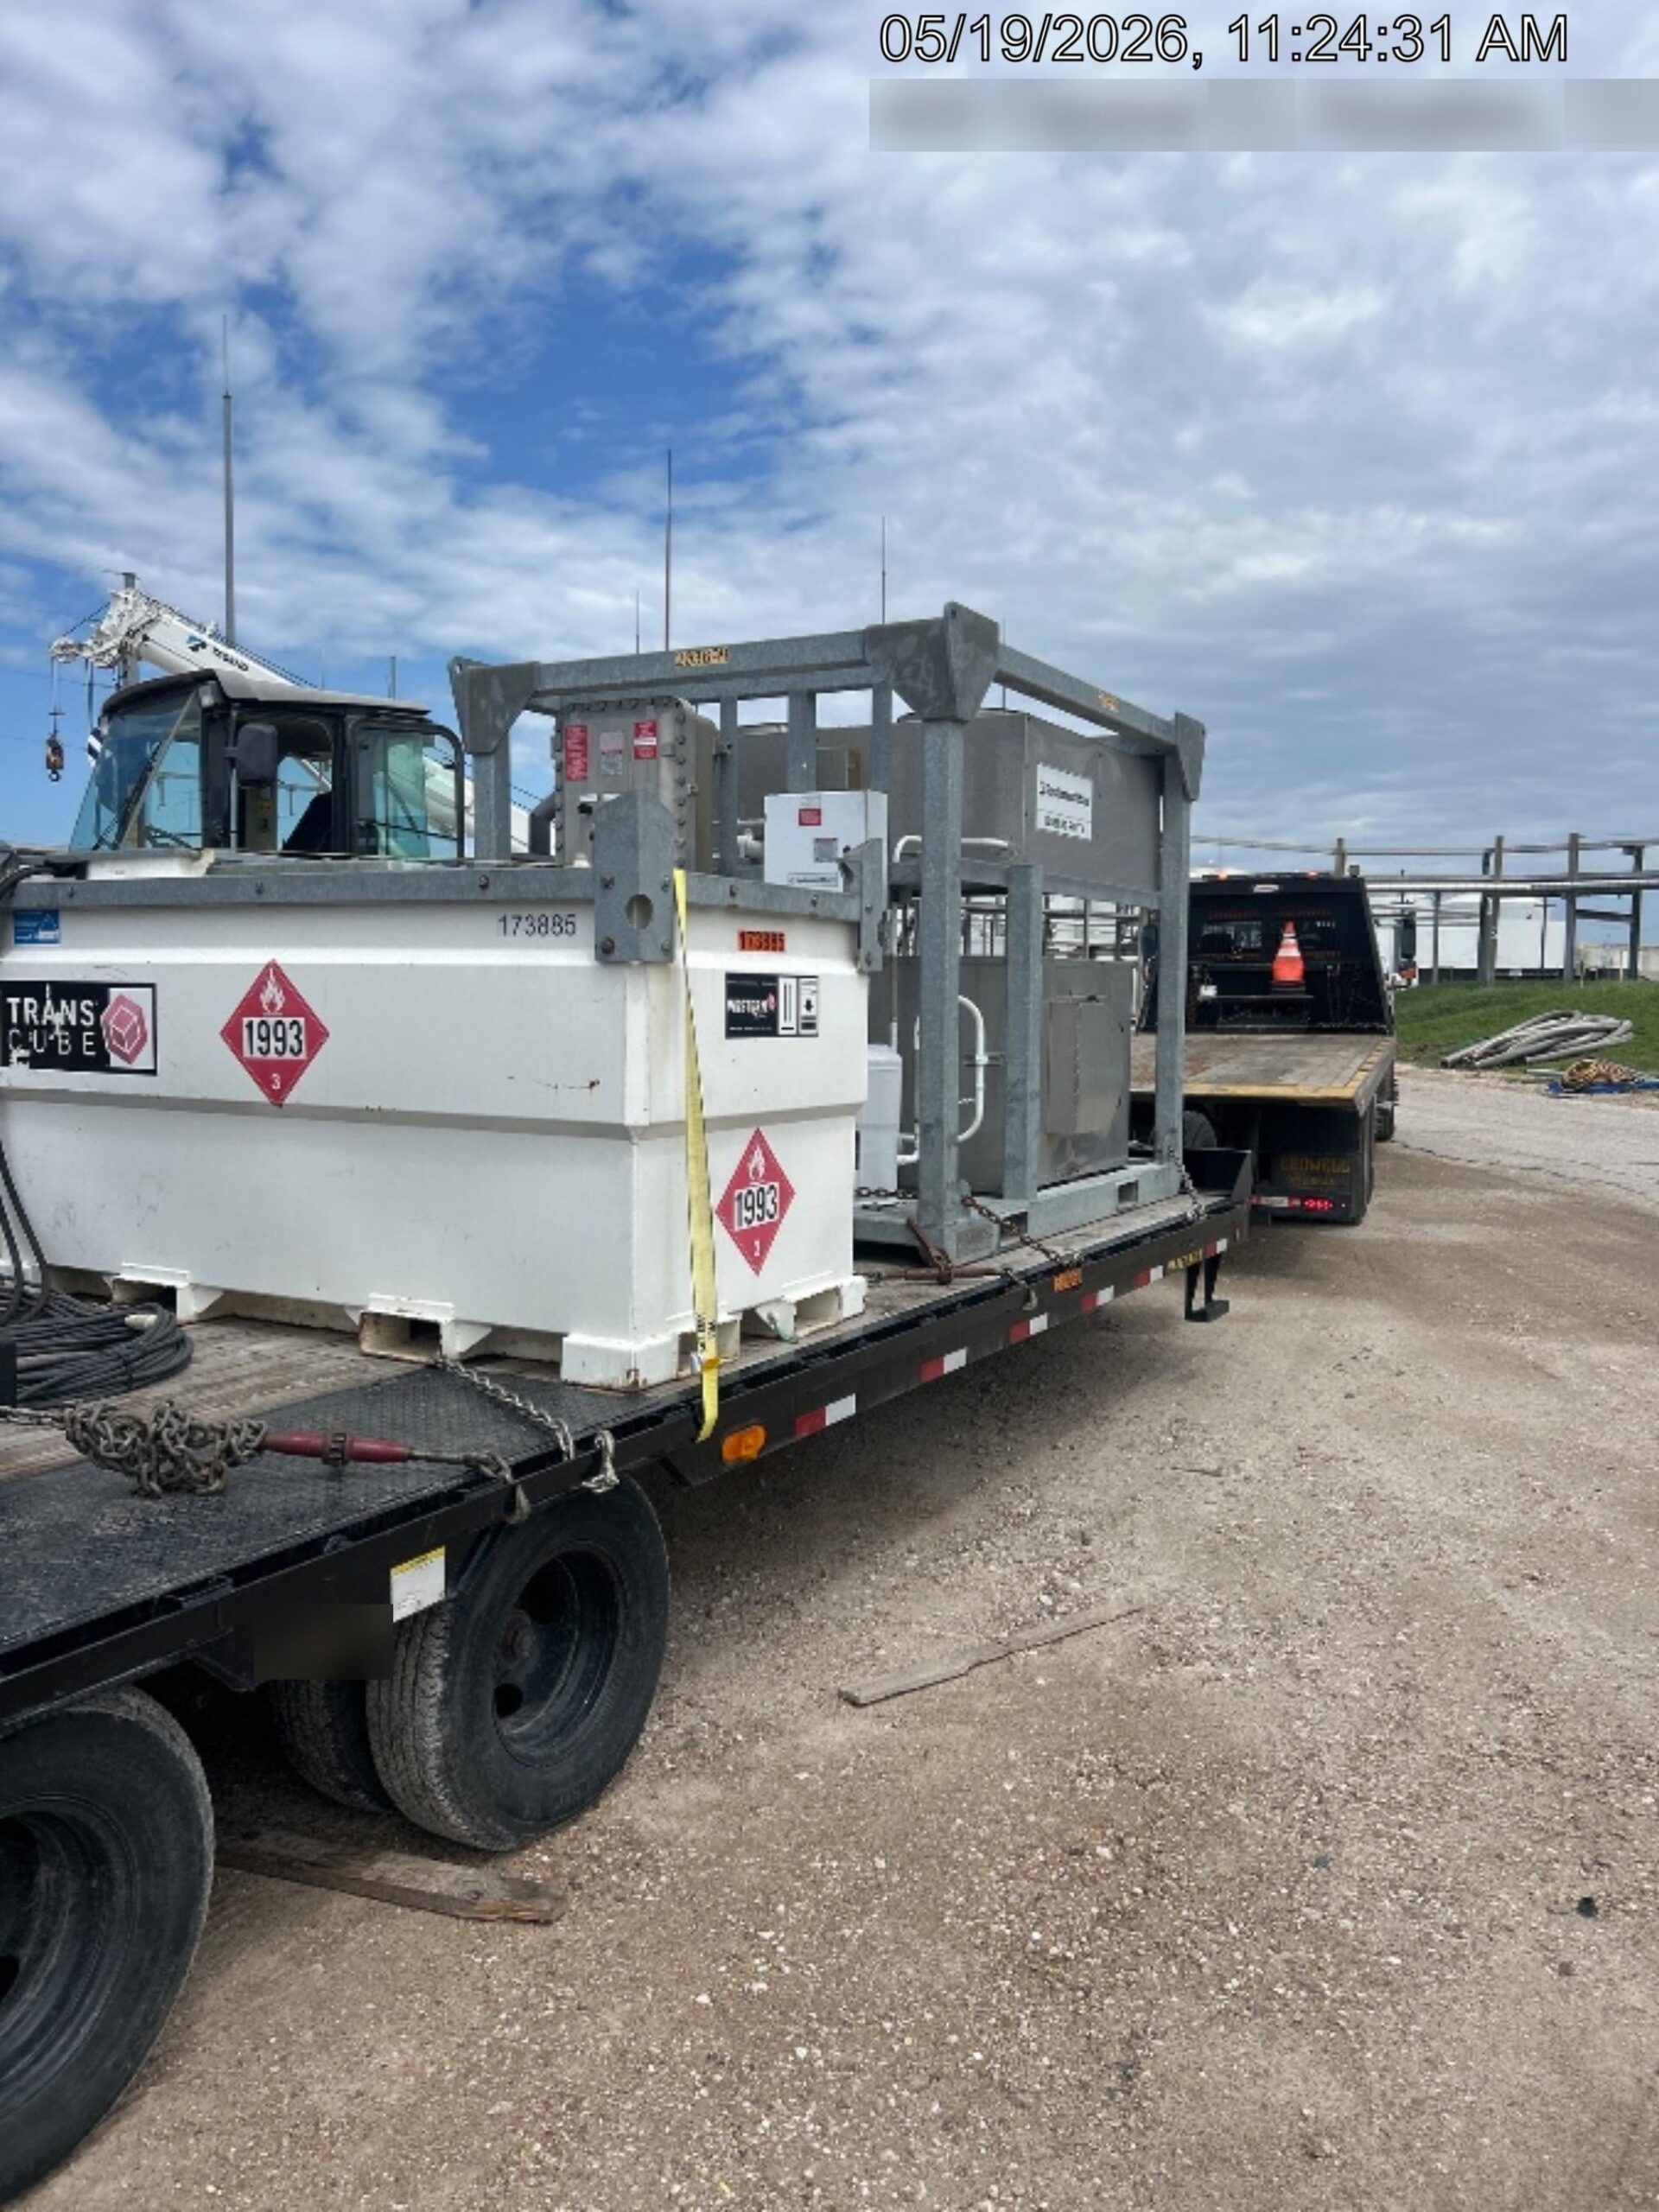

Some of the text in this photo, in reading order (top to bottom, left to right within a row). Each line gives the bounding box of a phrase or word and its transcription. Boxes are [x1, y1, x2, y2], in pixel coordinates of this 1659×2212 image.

[498, 913, 576, 938] 173885
[6, 996, 95, 1027] TRANS
[9, 1028, 97, 1056] CUBE
[245, 1020, 303, 1057] 1993
[270, 1072, 282, 1090] 3
[736, 1184, 778, 1228] 1993
